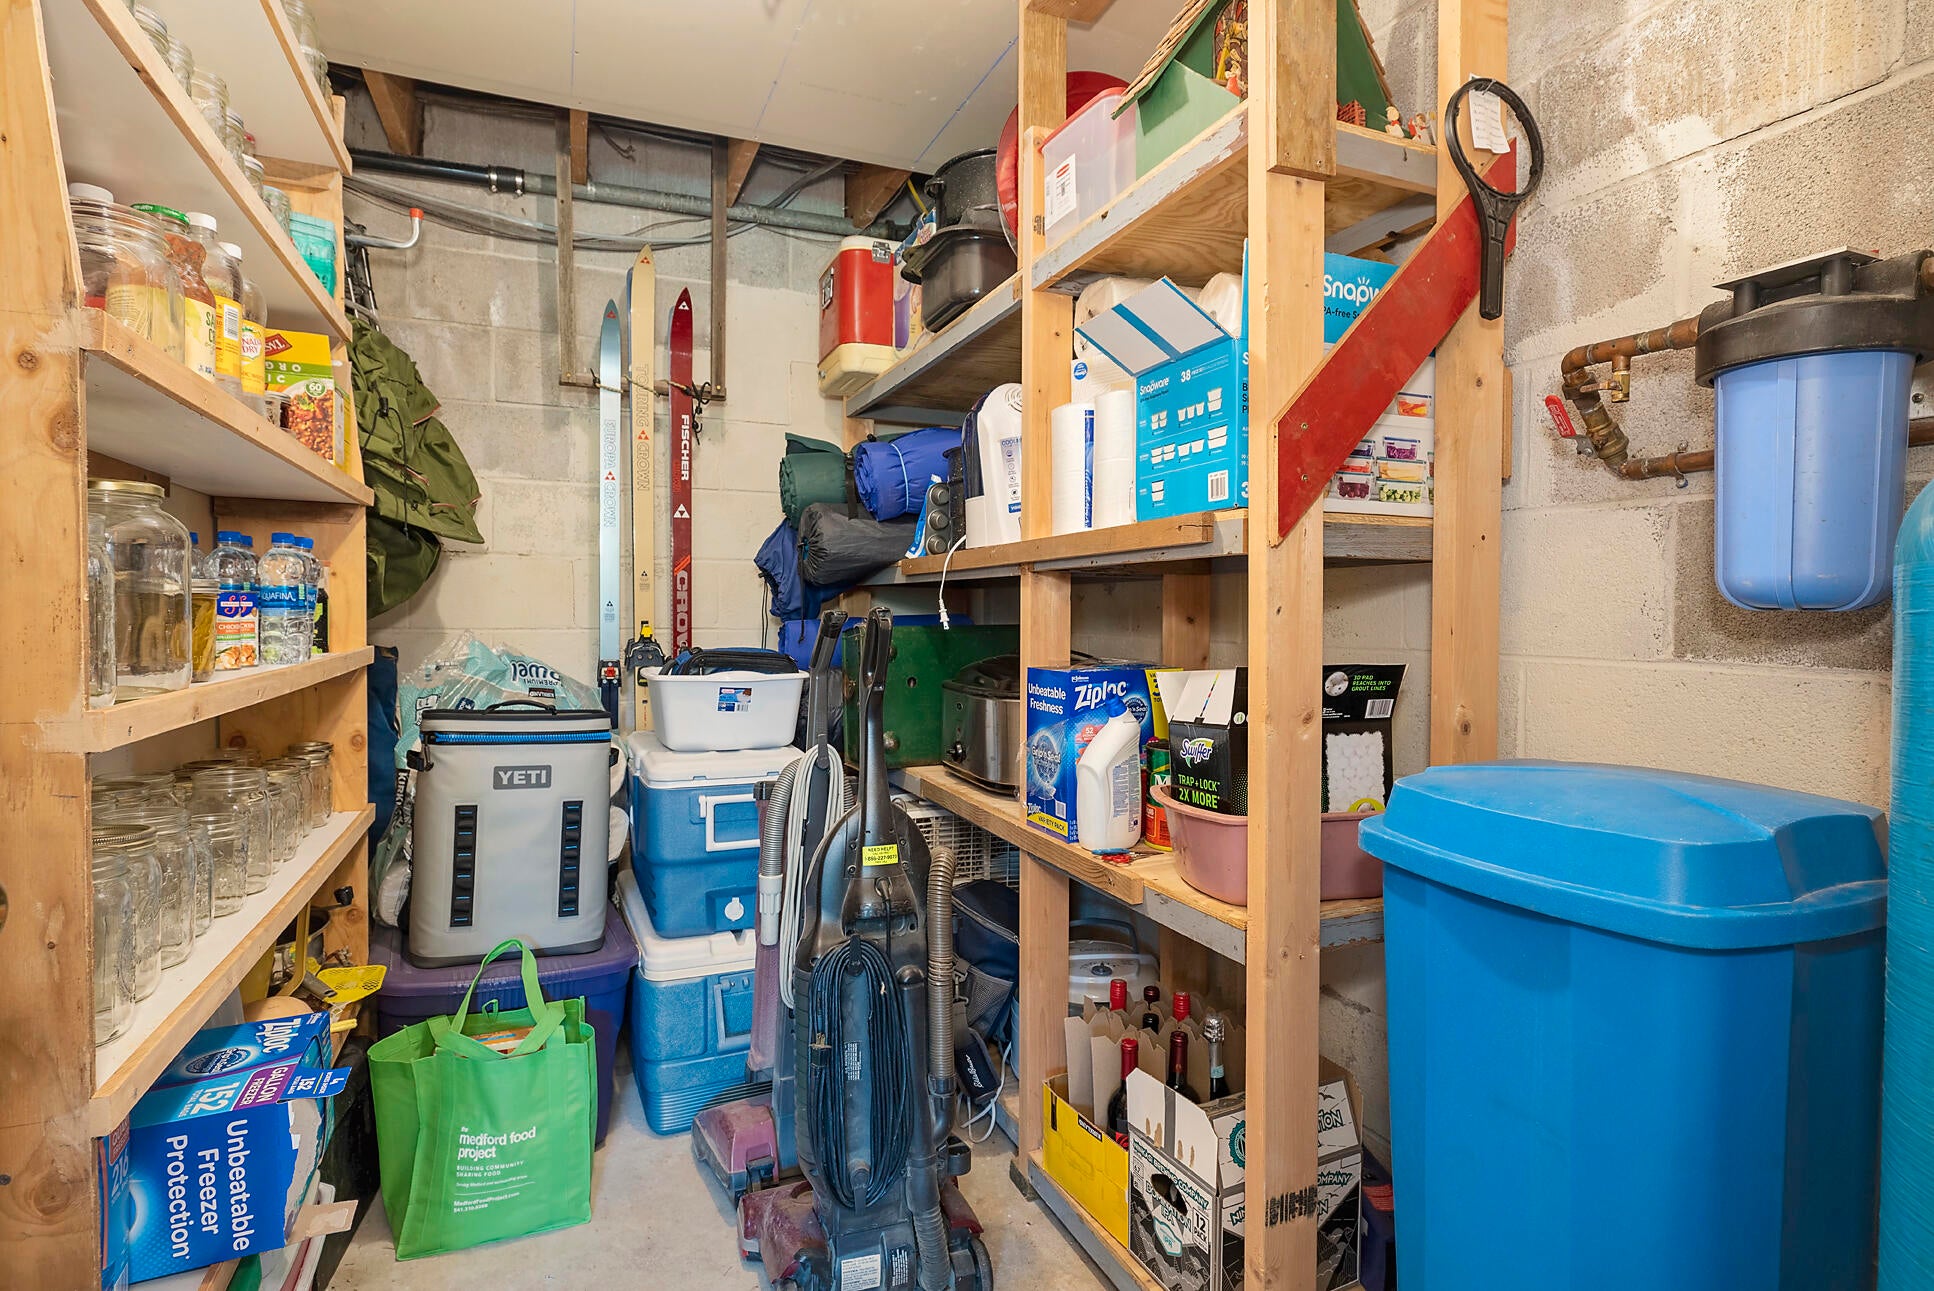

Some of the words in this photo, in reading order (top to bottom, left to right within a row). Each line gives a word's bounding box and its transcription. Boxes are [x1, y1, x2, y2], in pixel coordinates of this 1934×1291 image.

[308, 381, 323, 391] 60
[1180, 369, 1192, 382] 38
[1139, 377, 1170, 396] Snapware
[603, 419, 617, 470] EUROPA
[681, 414, 690, 481] FISCHER
[636, 441, 650, 492] CROWN
[603, 481, 617, 528] CROWN
[1028, 682, 1067, 701] Unbeatable
[1074, 680, 1127, 711] Ziploc
[1030, 697, 1064, 715] Freshness
[1181, 739, 1213, 764] Swiffer
[498, 769, 547, 785] YETI
[1178, 774, 1195, 786] TRAP
[395, 771, 409, 806] KIRK
[1178, 788, 1190, 801] 2X
[1191, 791, 1218, 809] MORE
[1038, 815, 1054, 828] VARIETY
[1054, 821, 1065, 832] PACK
[256, 1018, 301, 1054] Ziploc
[239, 1077, 266, 1106] FREEZER
[255, 1066, 289, 1103] GALLON
[296, 1077, 316, 1091] 152
[329, 1077, 345, 1086] 4
[190, 1081, 241, 1115] 152
[459, 1132, 507, 1146] medford
[509, 1126, 537, 1144] food
[457, 1145, 497, 1162] project
[486, 1160, 525, 1171] COMMUNITY
[197, 1148, 220, 1235] Freezer
[226, 1119, 255, 1251] Unbeatable
[1177, 1178, 1209, 1209] COMPANY
[1195, 1212, 1206, 1233] 12
[1193, 1228, 1208, 1244] PACK
